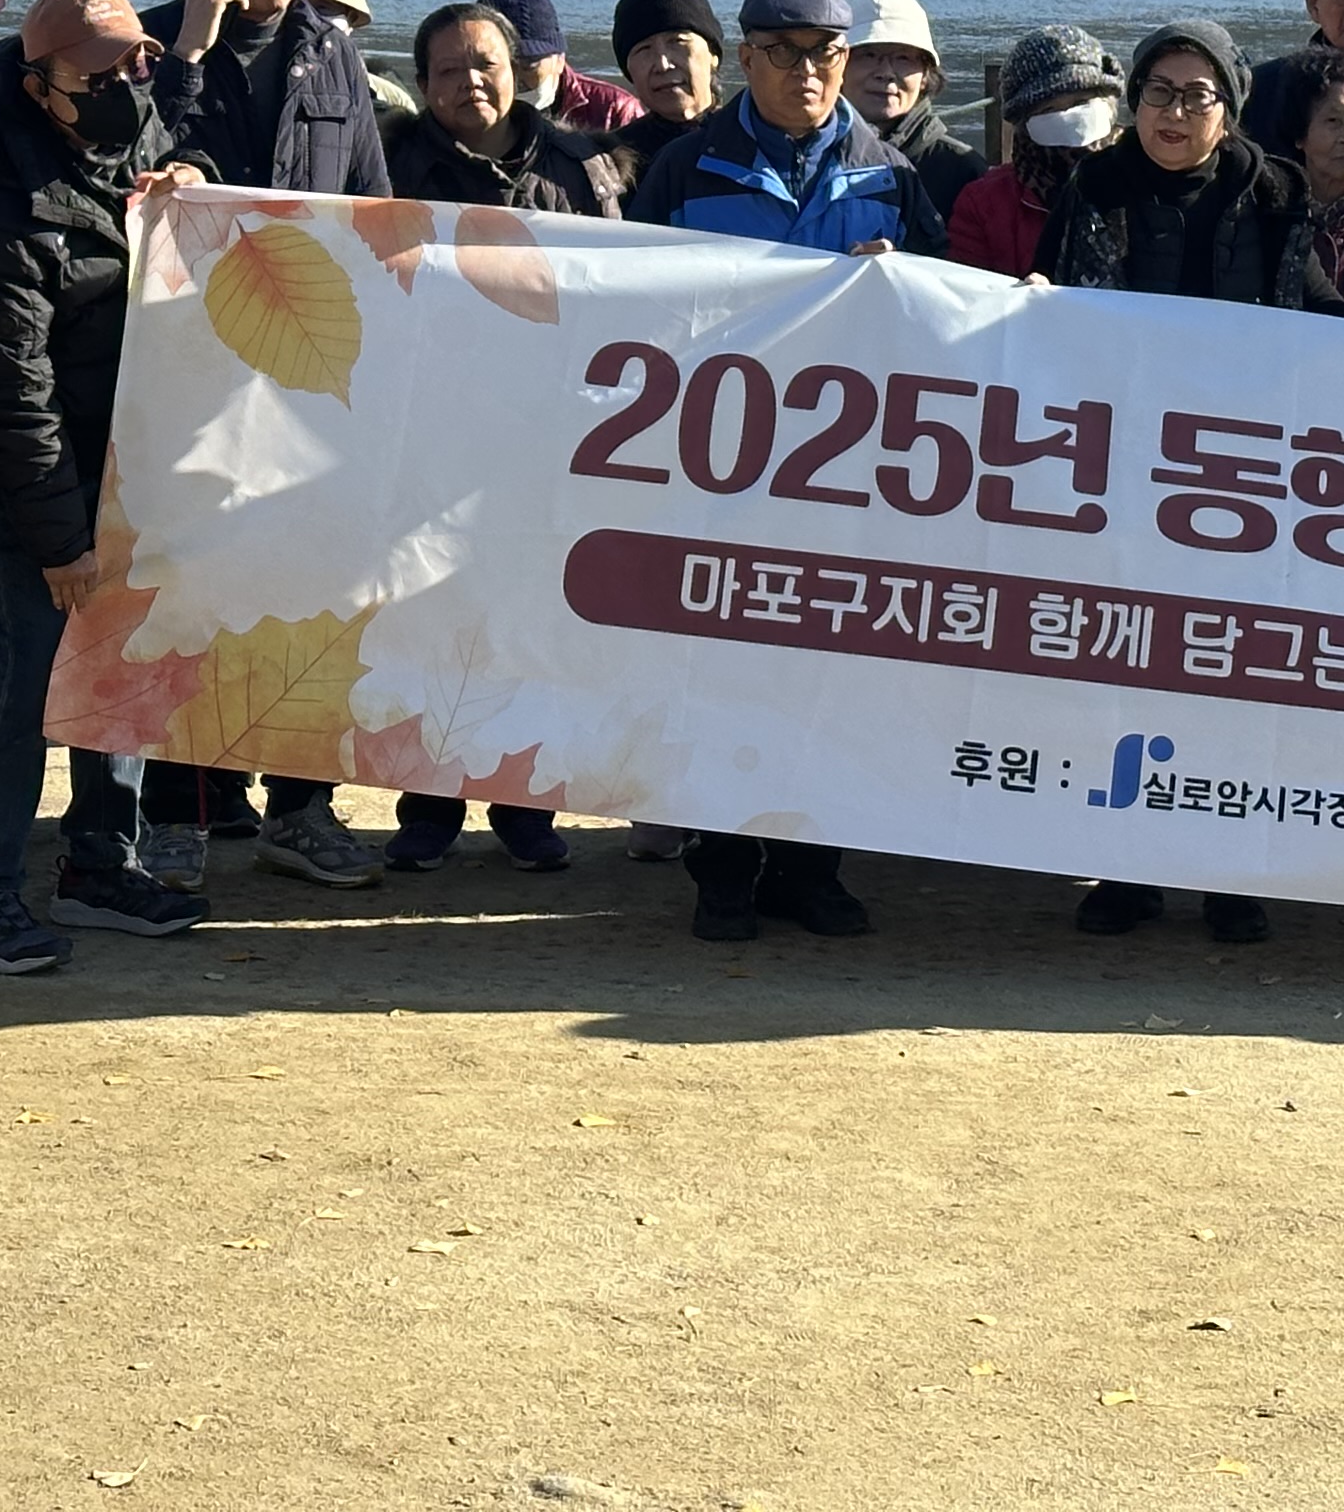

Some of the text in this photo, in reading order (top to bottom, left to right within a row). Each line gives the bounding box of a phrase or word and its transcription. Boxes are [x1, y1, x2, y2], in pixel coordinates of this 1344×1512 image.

[567, 339, 1115, 536] 2025년
[679, 553, 999, 651] 마포구지회
[1028, 591, 1155, 670] 함께
[950, 740, 1040, 795] 후원
